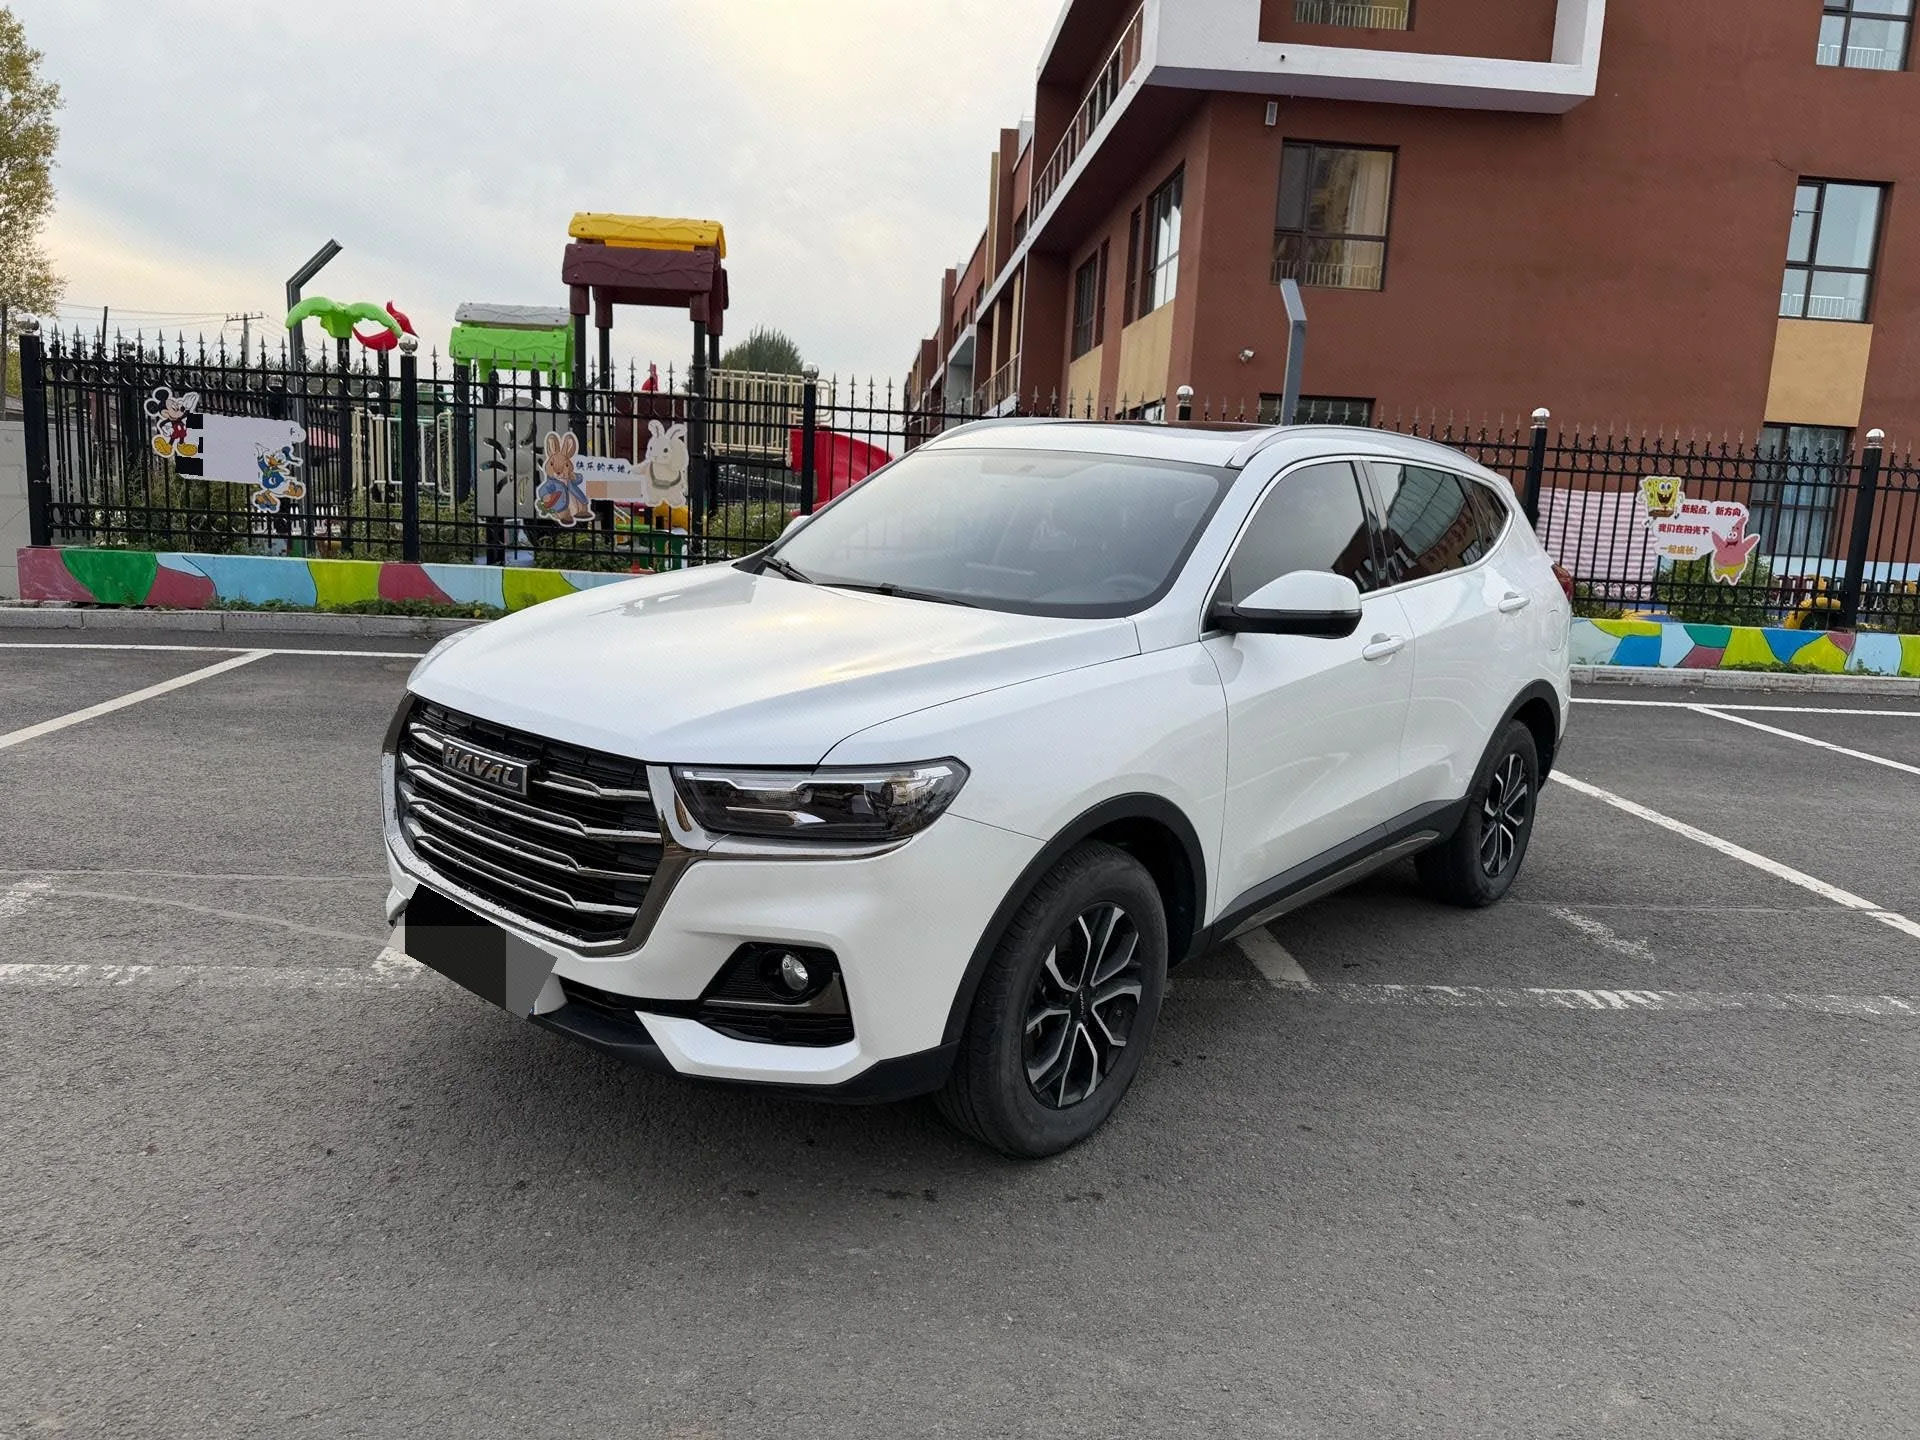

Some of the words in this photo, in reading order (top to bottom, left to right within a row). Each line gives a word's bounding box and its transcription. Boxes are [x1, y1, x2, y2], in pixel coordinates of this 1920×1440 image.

[1657, 523, 1710, 535] 我们在阳光下
[445, 746, 519, 787] HAVAL
